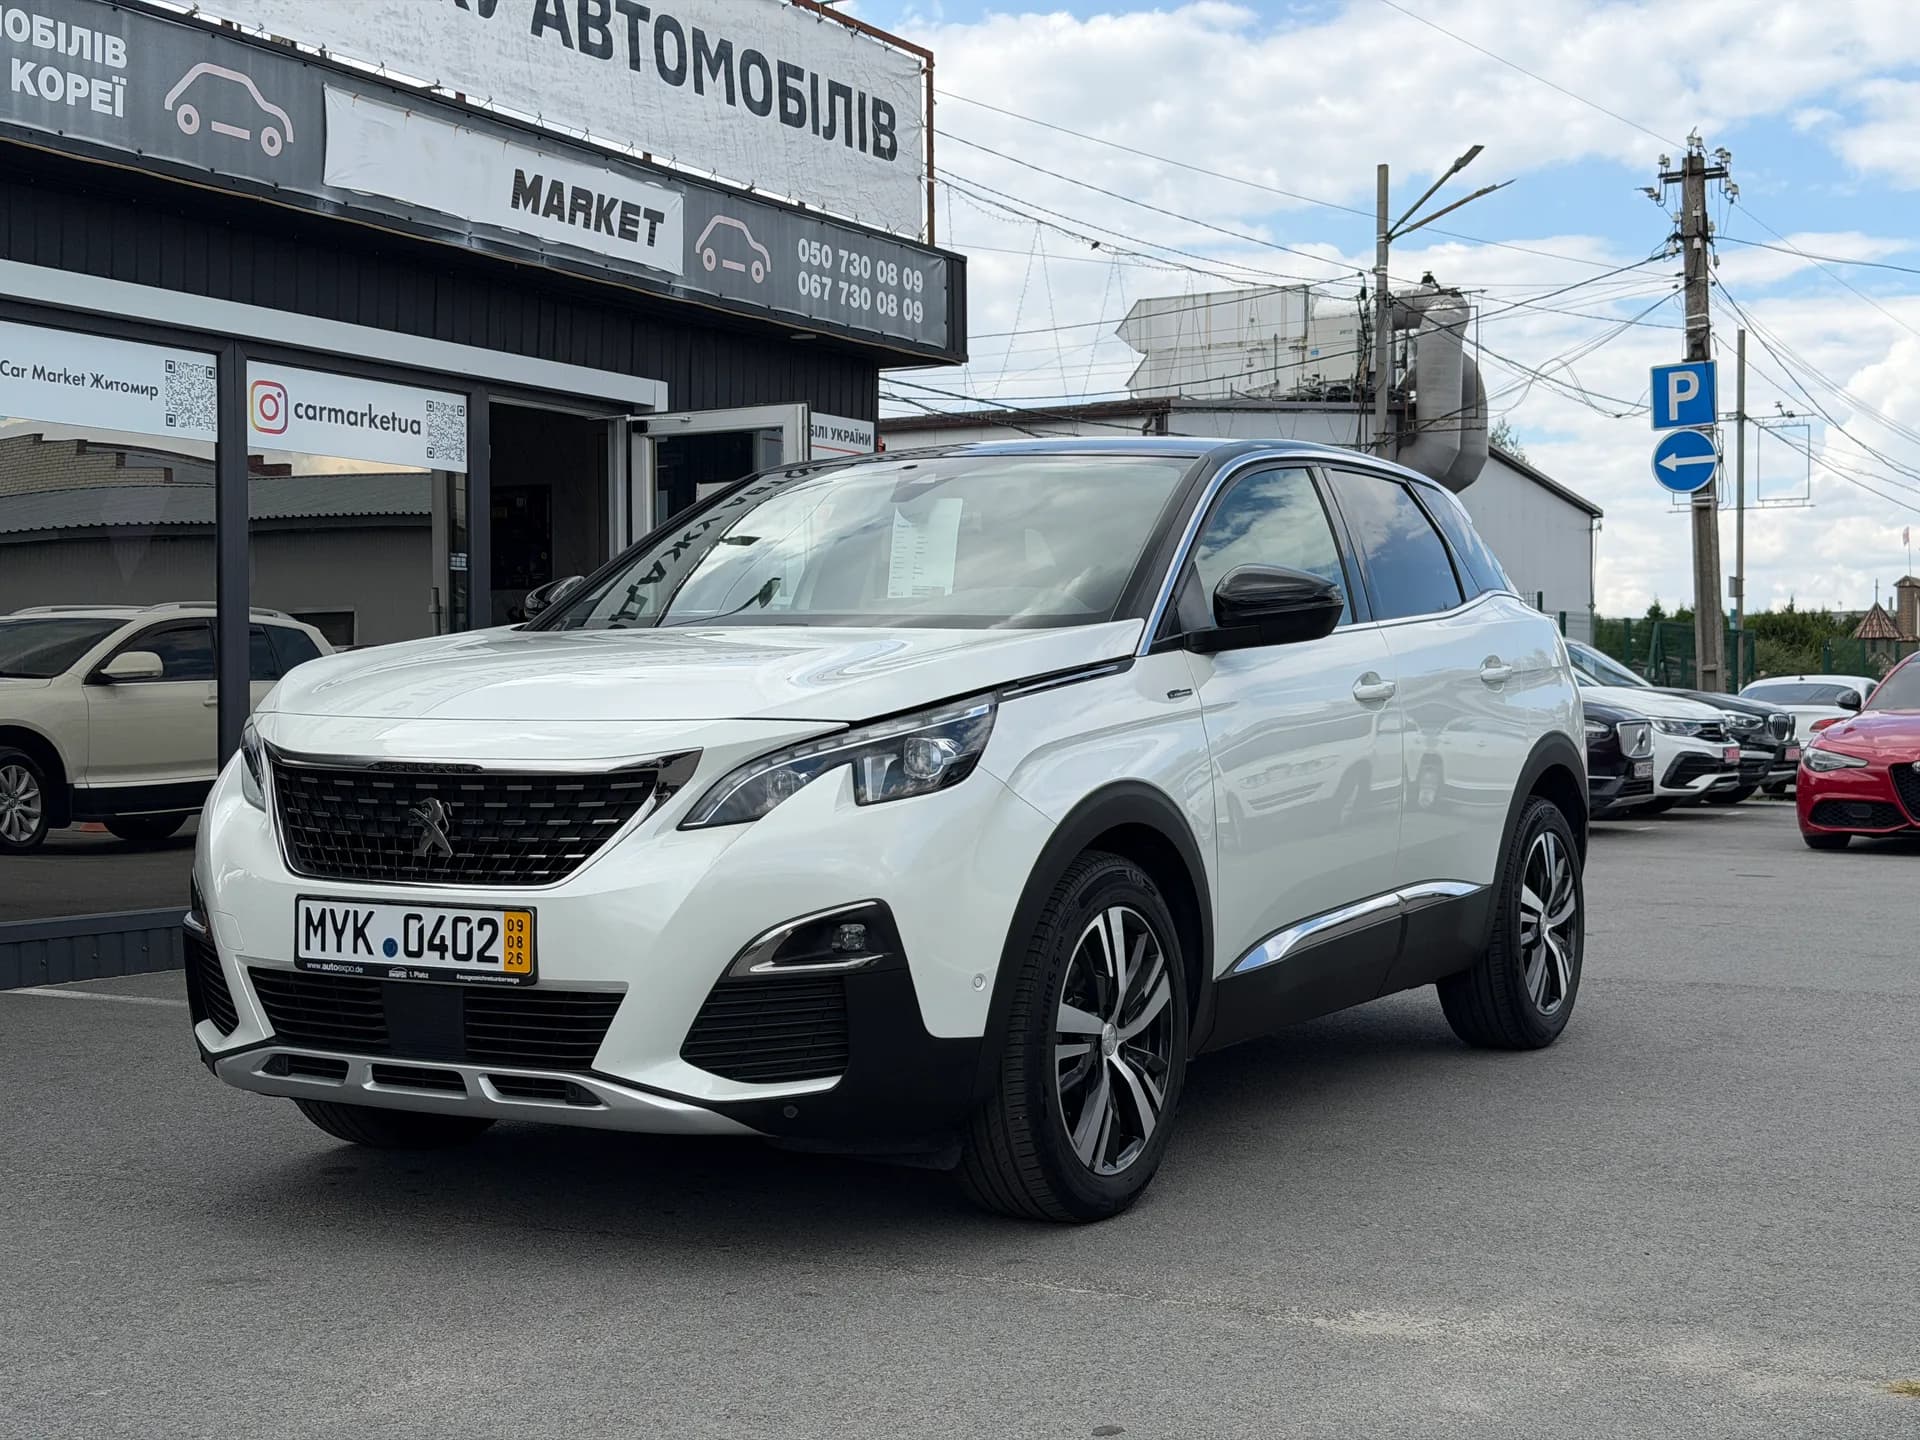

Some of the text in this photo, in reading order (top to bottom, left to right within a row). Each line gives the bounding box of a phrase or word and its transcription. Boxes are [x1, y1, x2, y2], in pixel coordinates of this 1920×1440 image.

[0, 4, 128, 69] ОБІЛІВ
[11, 57, 128, 118] КОРЕЇ
[530, 0, 898, 162] АВТОМОБІЛІВ
[511, 168, 665, 248] MARKET
[797, 238, 923, 293] 050 730 08 09
[797, 271, 923, 324] 067 730 08 09
[0, 359, 159, 401] Car Market Житомир
[1668, 371, 1699, 421] P
[293, 397, 422, 436] carmarketua
[830, 427, 872, 447] УКРАЇНИ
[305, 906, 499, 964] MYK 0402
[506, 918, 524, 932] 09
[506, 935, 524, 949] 08
[507, 951, 524, 965] 26
